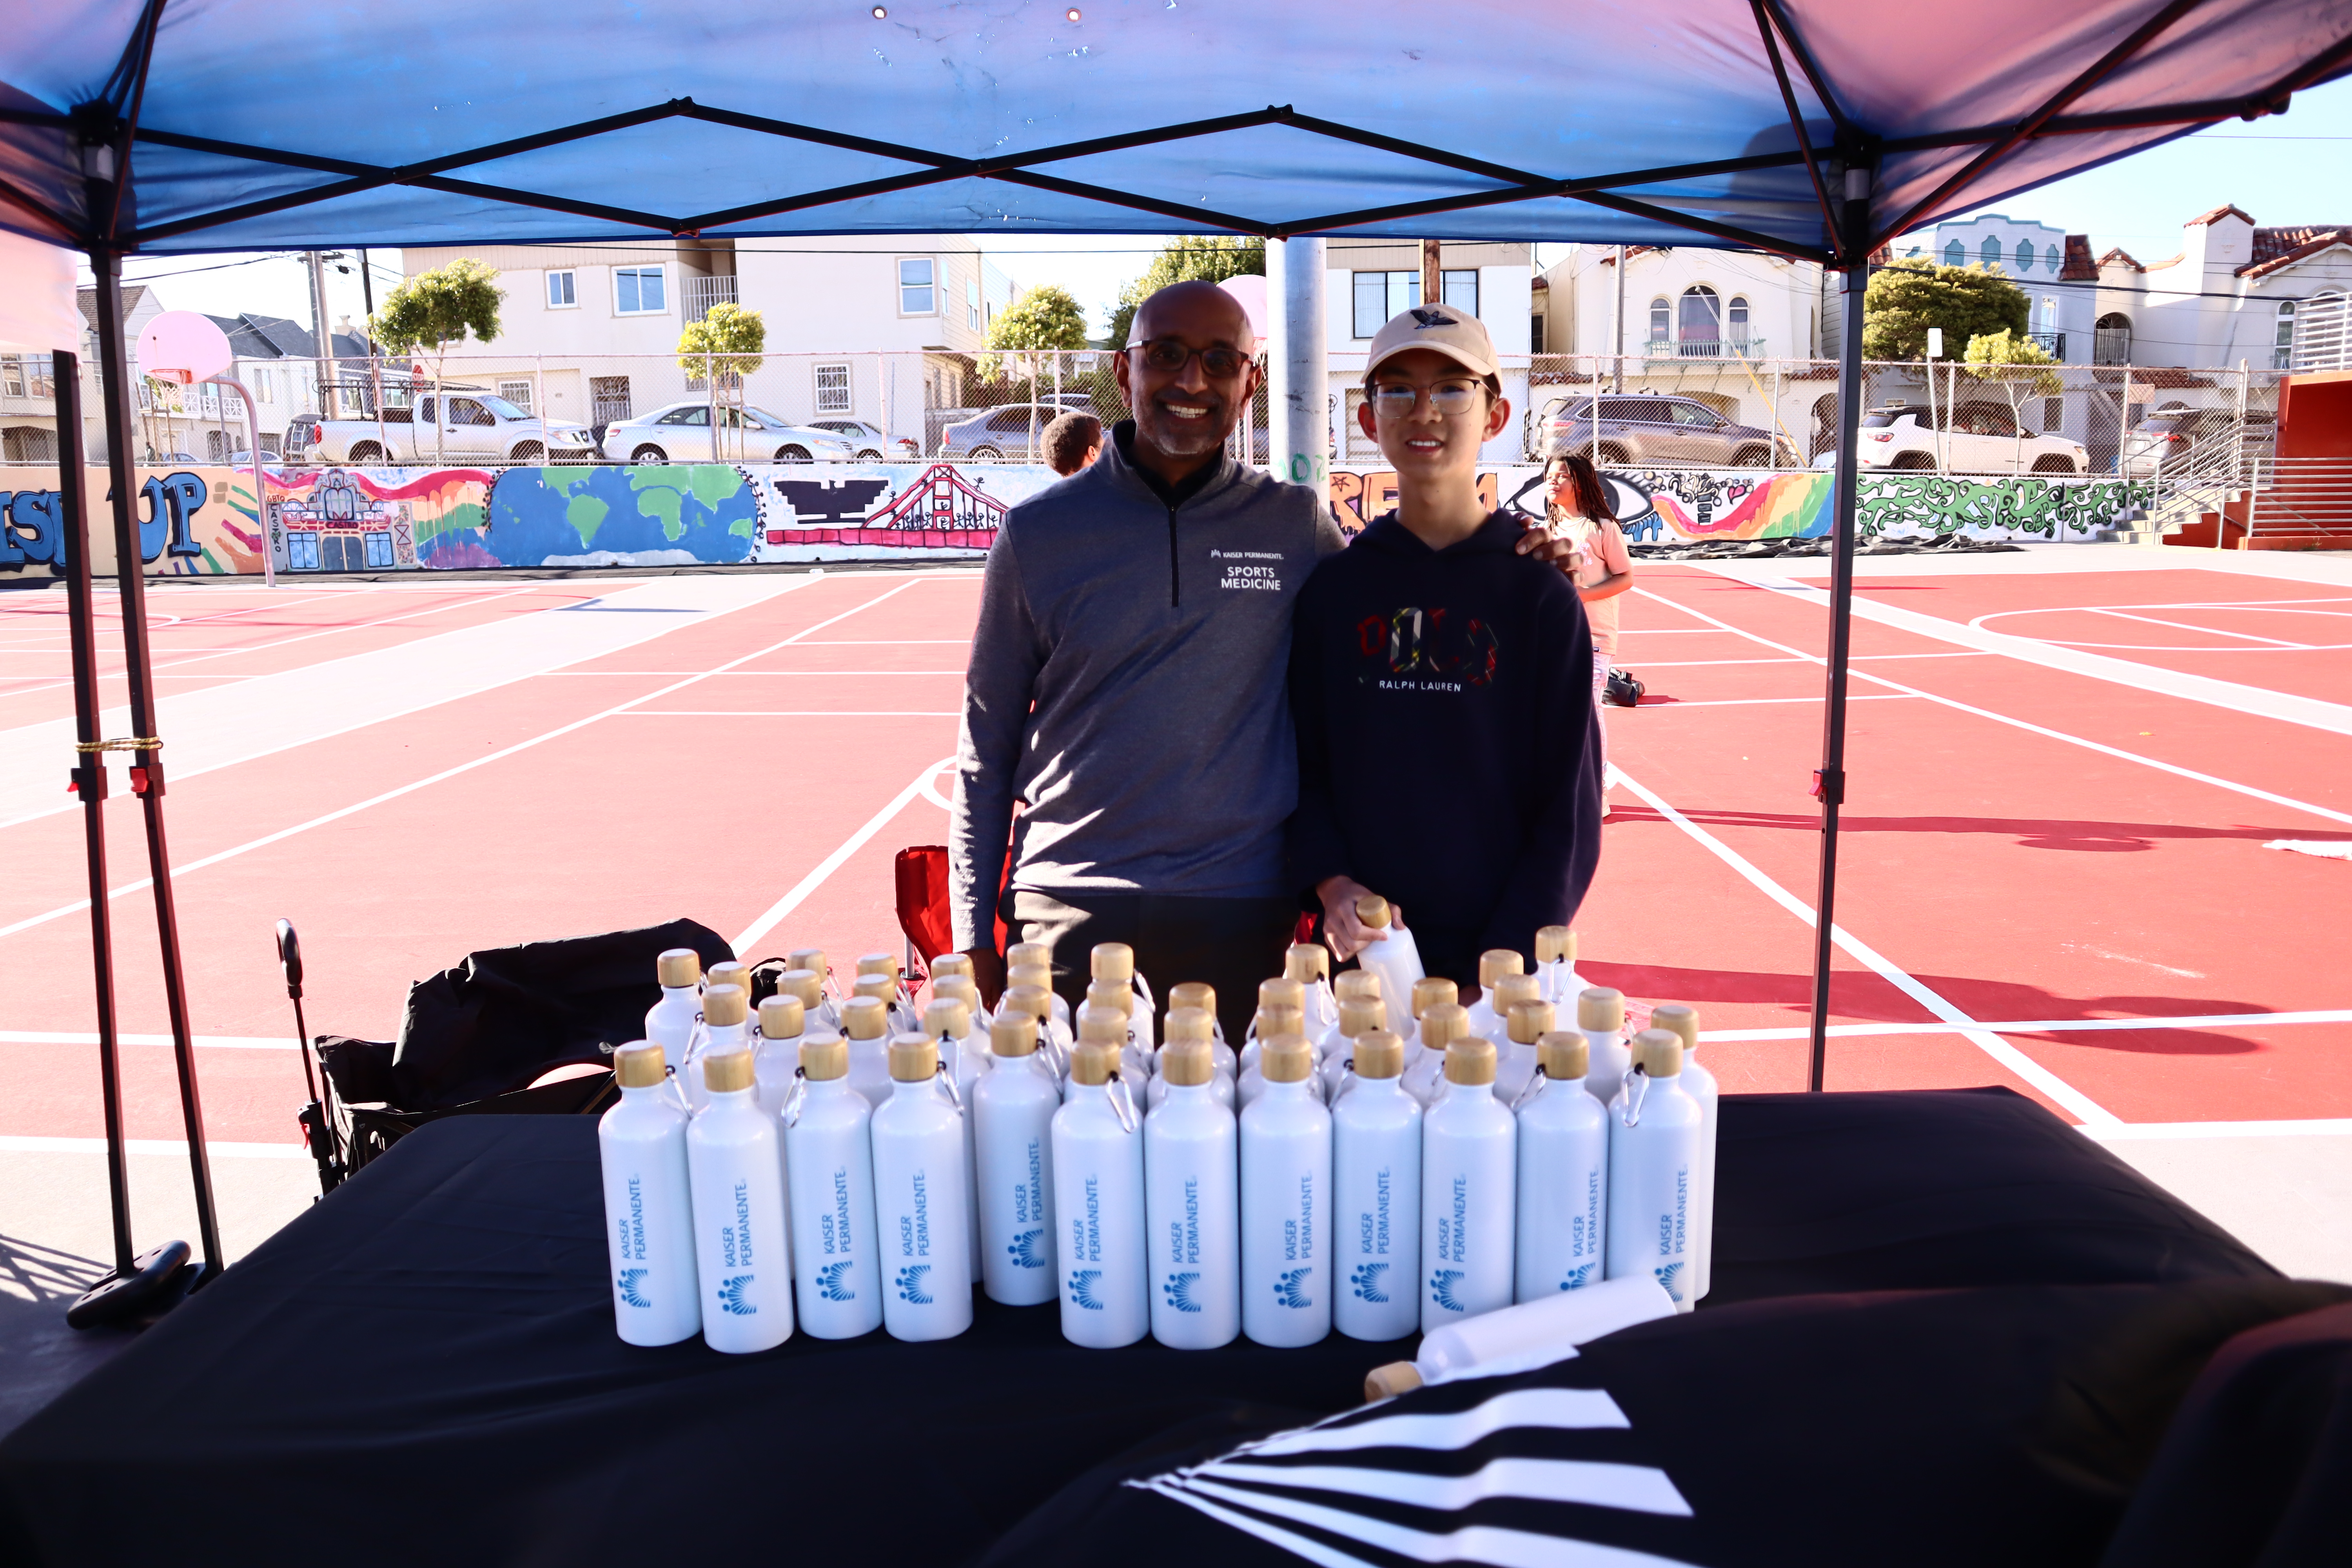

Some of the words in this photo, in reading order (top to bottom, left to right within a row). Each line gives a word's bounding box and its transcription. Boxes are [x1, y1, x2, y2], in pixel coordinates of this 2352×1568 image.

[1221, 578, 1281, 590] MEDICINE
[1227, 566, 1275, 578] SPORTS
[1379, 680, 1415, 690] RALPH
[1421, 681, 1461, 692] LAUREN
[1016, 1185, 1027, 1222] KAISER
[619, 1220, 630, 1259] KAISER
[722, 1227, 736, 1267] KAISER
[823, 1214, 835, 1254] KAISER
[902, 1216, 913, 1256] KAISER
[1074, 1219, 1085, 1260] KAISER
[1172, 1222, 1183, 1263] KAISER
[1285, 1220, 1296, 1260] KAISER
[1362, 1213, 1373, 1254] KAISER
[1439, 1218, 1450, 1259] KAISER
[1573, 1216, 1584, 1257] KAISER
[1660, 1214, 1672, 1255] KAISER
